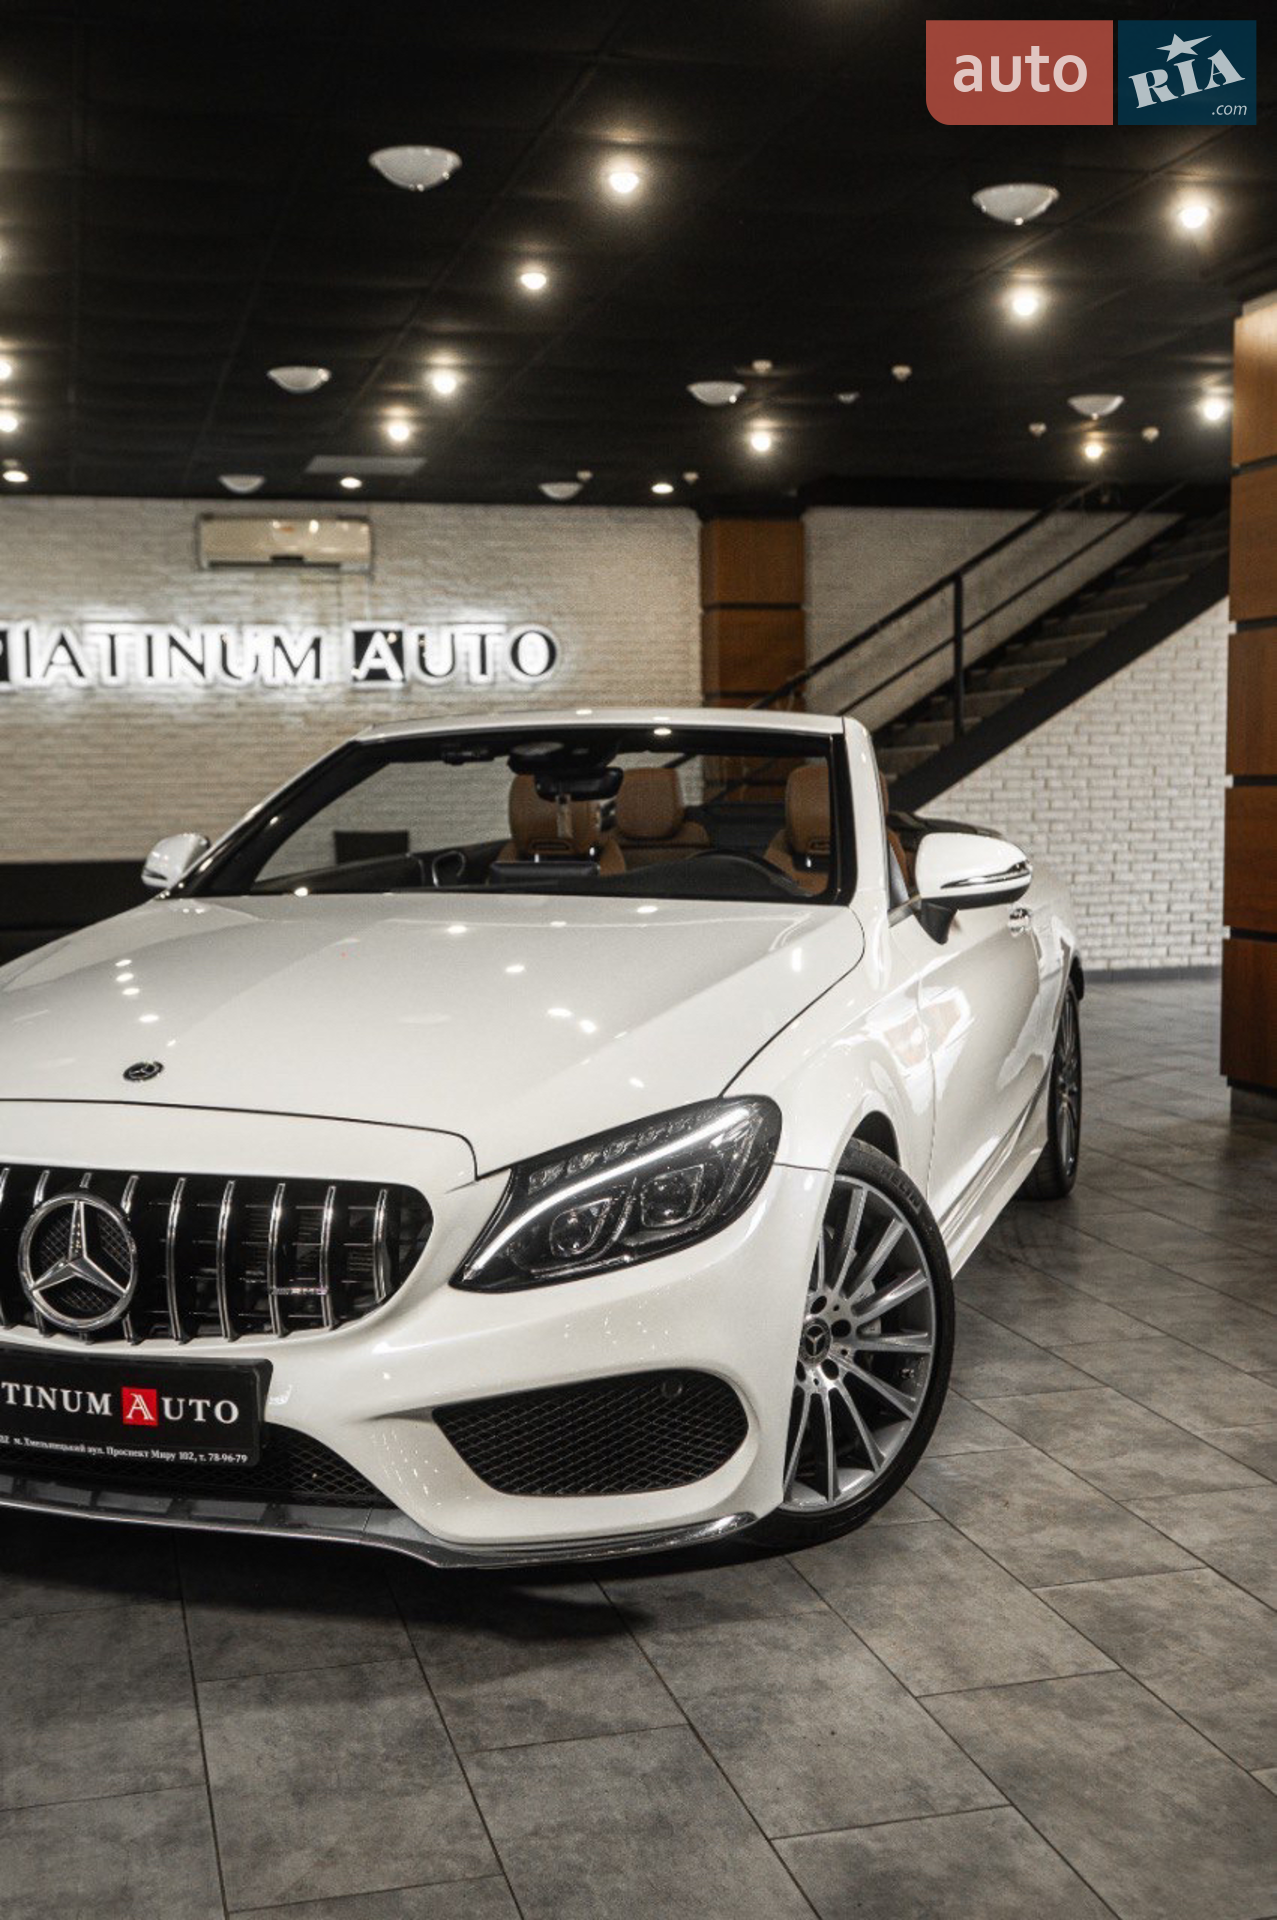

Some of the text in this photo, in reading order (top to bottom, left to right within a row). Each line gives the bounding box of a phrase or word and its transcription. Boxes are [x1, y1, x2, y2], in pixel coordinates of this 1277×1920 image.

[0, 626, 558, 684] LATINUM AUTO
[1, 1381, 239, 1424] TINUM AUTO
[106, 1445, 149, 1458] Проспект
[151, 1449, 177, 1461] Миру
[208, 1452, 248, 1463] 78-96-79
